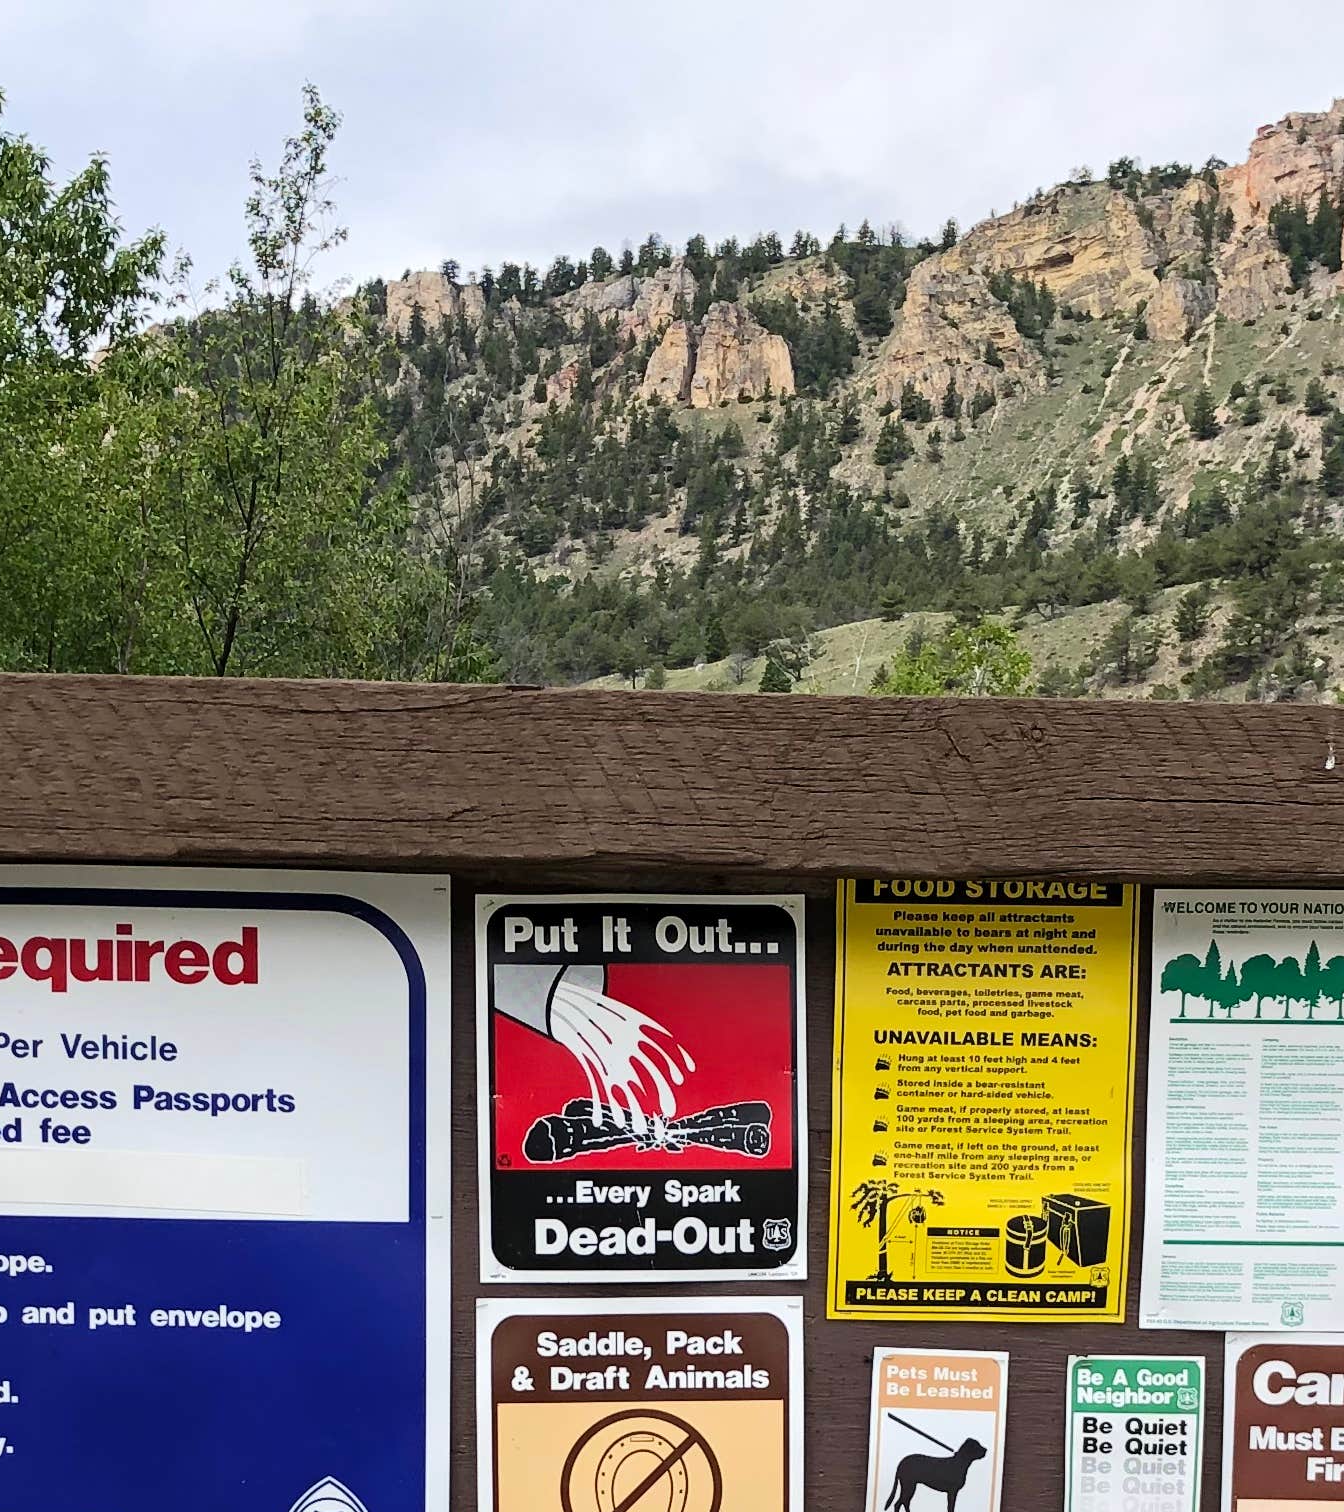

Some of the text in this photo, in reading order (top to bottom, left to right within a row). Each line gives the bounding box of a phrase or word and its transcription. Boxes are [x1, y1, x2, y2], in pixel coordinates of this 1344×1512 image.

[873, 879, 1108, 900] FOOD STORAGE
[893, 910, 1075, 925] Please keep all attractants
[1161, 901, 1237, 914] WELCOME
[1238, 901, 1258, 914] TO
[1260, 902, 1300, 915] YOUR
[505, 916, 778, 953] Put It Out...
[887, 961, 1087, 979] ATTRACTANTS ARE:
[61, 1034, 177, 1061] Vehicle
[873, 1029, 1098, 1048] UNAVAILABLE MEANS:
[134, 1085, 295, 1116] Passports
[40, 1118, 91, 1144] fee
[547, 1180, 741, 1207] ...Every Spark
[535, 1217, 754, 1255] Dead-Out
[855, 1287, 1096, 1303] PLEASE KEEP A CLEAN CAMP!
[22, 1302, 74, 1324] and
[90, 1305, 136, 1329] put
[151, 1305, 281, 1332] envelope
[537, 1330, 742, 1360] Saddle, Pack
[512, 1365, 769, 1391] & Draft Animals
[886, 1364, 978, 1382] Pets Must
[1077, 1368, 1189, 1387] Be A Good
[885, 1381, 993, 1400] Be Leashed
[1077, 1386, 1175, 1408] Neighbor
[1082, 1416, 1188, 1436] Be Quiet
[1082, 1436, 1188, 1456] Be Quiet
[1250, 1426, 1323, 1450] Must
